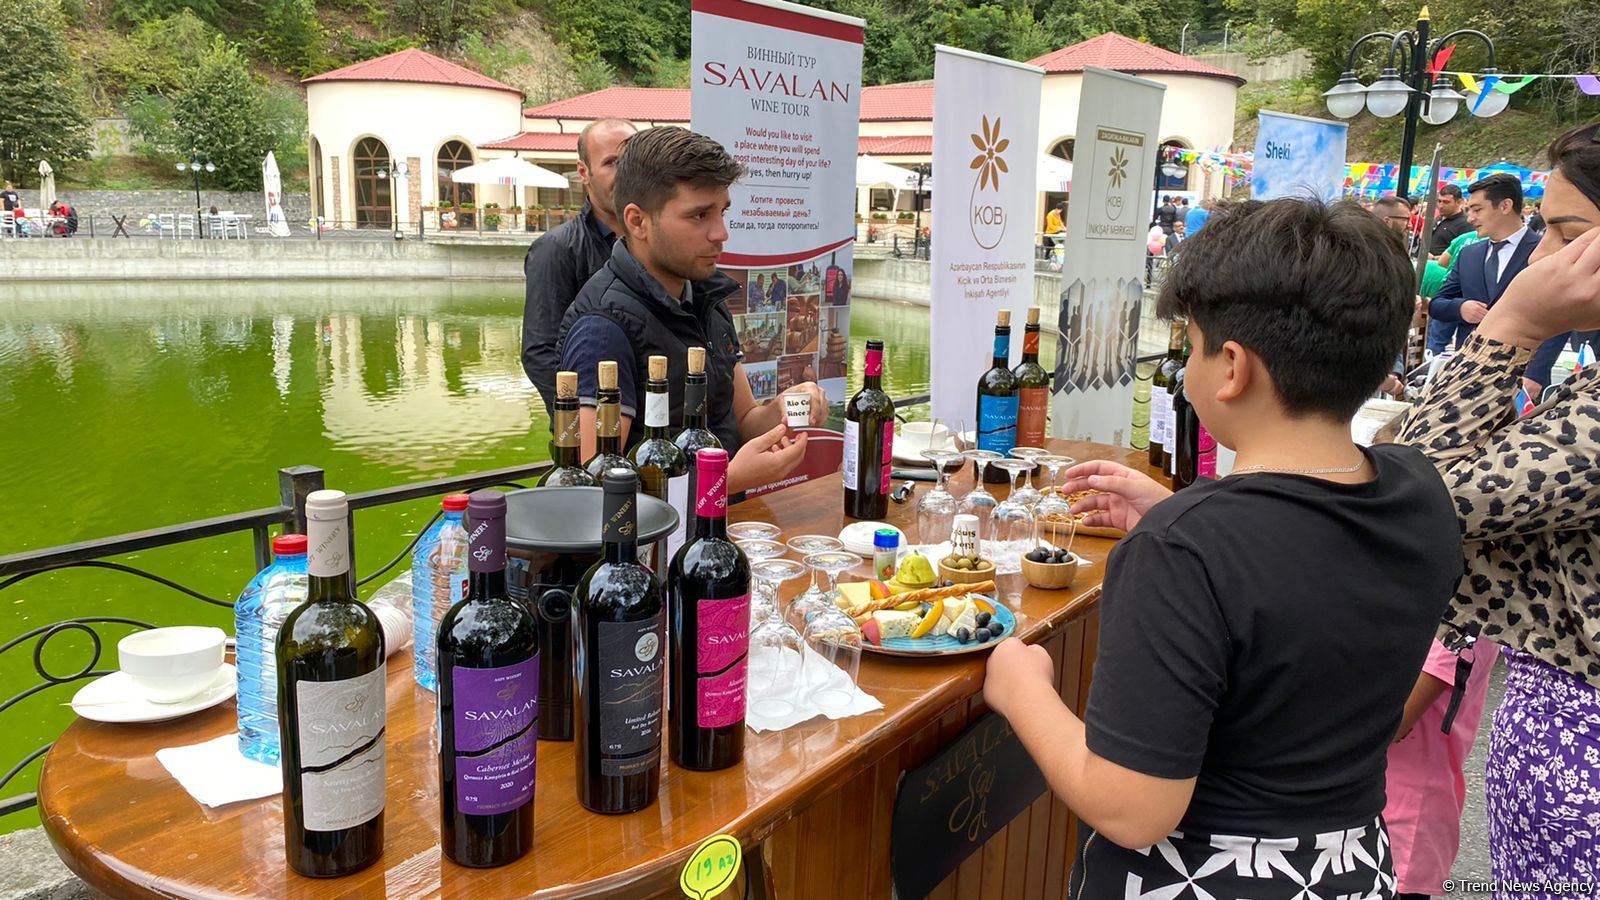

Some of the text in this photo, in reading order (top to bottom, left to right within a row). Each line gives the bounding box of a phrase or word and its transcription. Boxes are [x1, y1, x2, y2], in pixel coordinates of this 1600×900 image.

[747, 46, 817, 69] ВИННЫЙ ТУР
[703, 61, 850, 103] SAVALAN
[751, 98, 810, 117] WINE TOUR
[745, 127, 813, 141] Would you like to visit
[740, 139, 757, 150] place
[758, 142, 778, 151] where
[779, 145, 790, 154] you
[791, 144, 803, 153] will
[804, 146, 820, 156] spend
[1266, 141, 1291, 160] Sheki
[750, 154, 785, 167] interesting
[785, 157, 797, 168] day
[797, 157, 805, 166] of
[805, 160, 818, 169] your
[818, 159, 832, 168] life?
[750, 168, 764, 178] yes,
[765, 168, 781, 177] then
[782, 168, 800, 181] hurry
[750, 194, 804, 206] Хотите провести
[1107, 196, 1122, 208] KOB
[741, 207, 812, 218] незабываемый день?
[974, 205, 1003, 225] KOB
[729, 220, 745, 229] Если
[745, 222, 757, 230] да,
[757, 222, 775, 230] тогда
[980, 275, 993, 285] Orta
[706, 473, 727, 497] WINERY
[315, 525, 341, 554] WINERY
[610, 656, 665, 678] SAVALA
[464, 695, 537, 721] SAVALAN
[311, 708, 385, 734] SAVALAN
[625, 713, 647, 724] Limited
[476, 762, 511, 773] Cabernet
[919, 718, 1013, 804] SAVALA
[696, 857, 712, 881] 19
